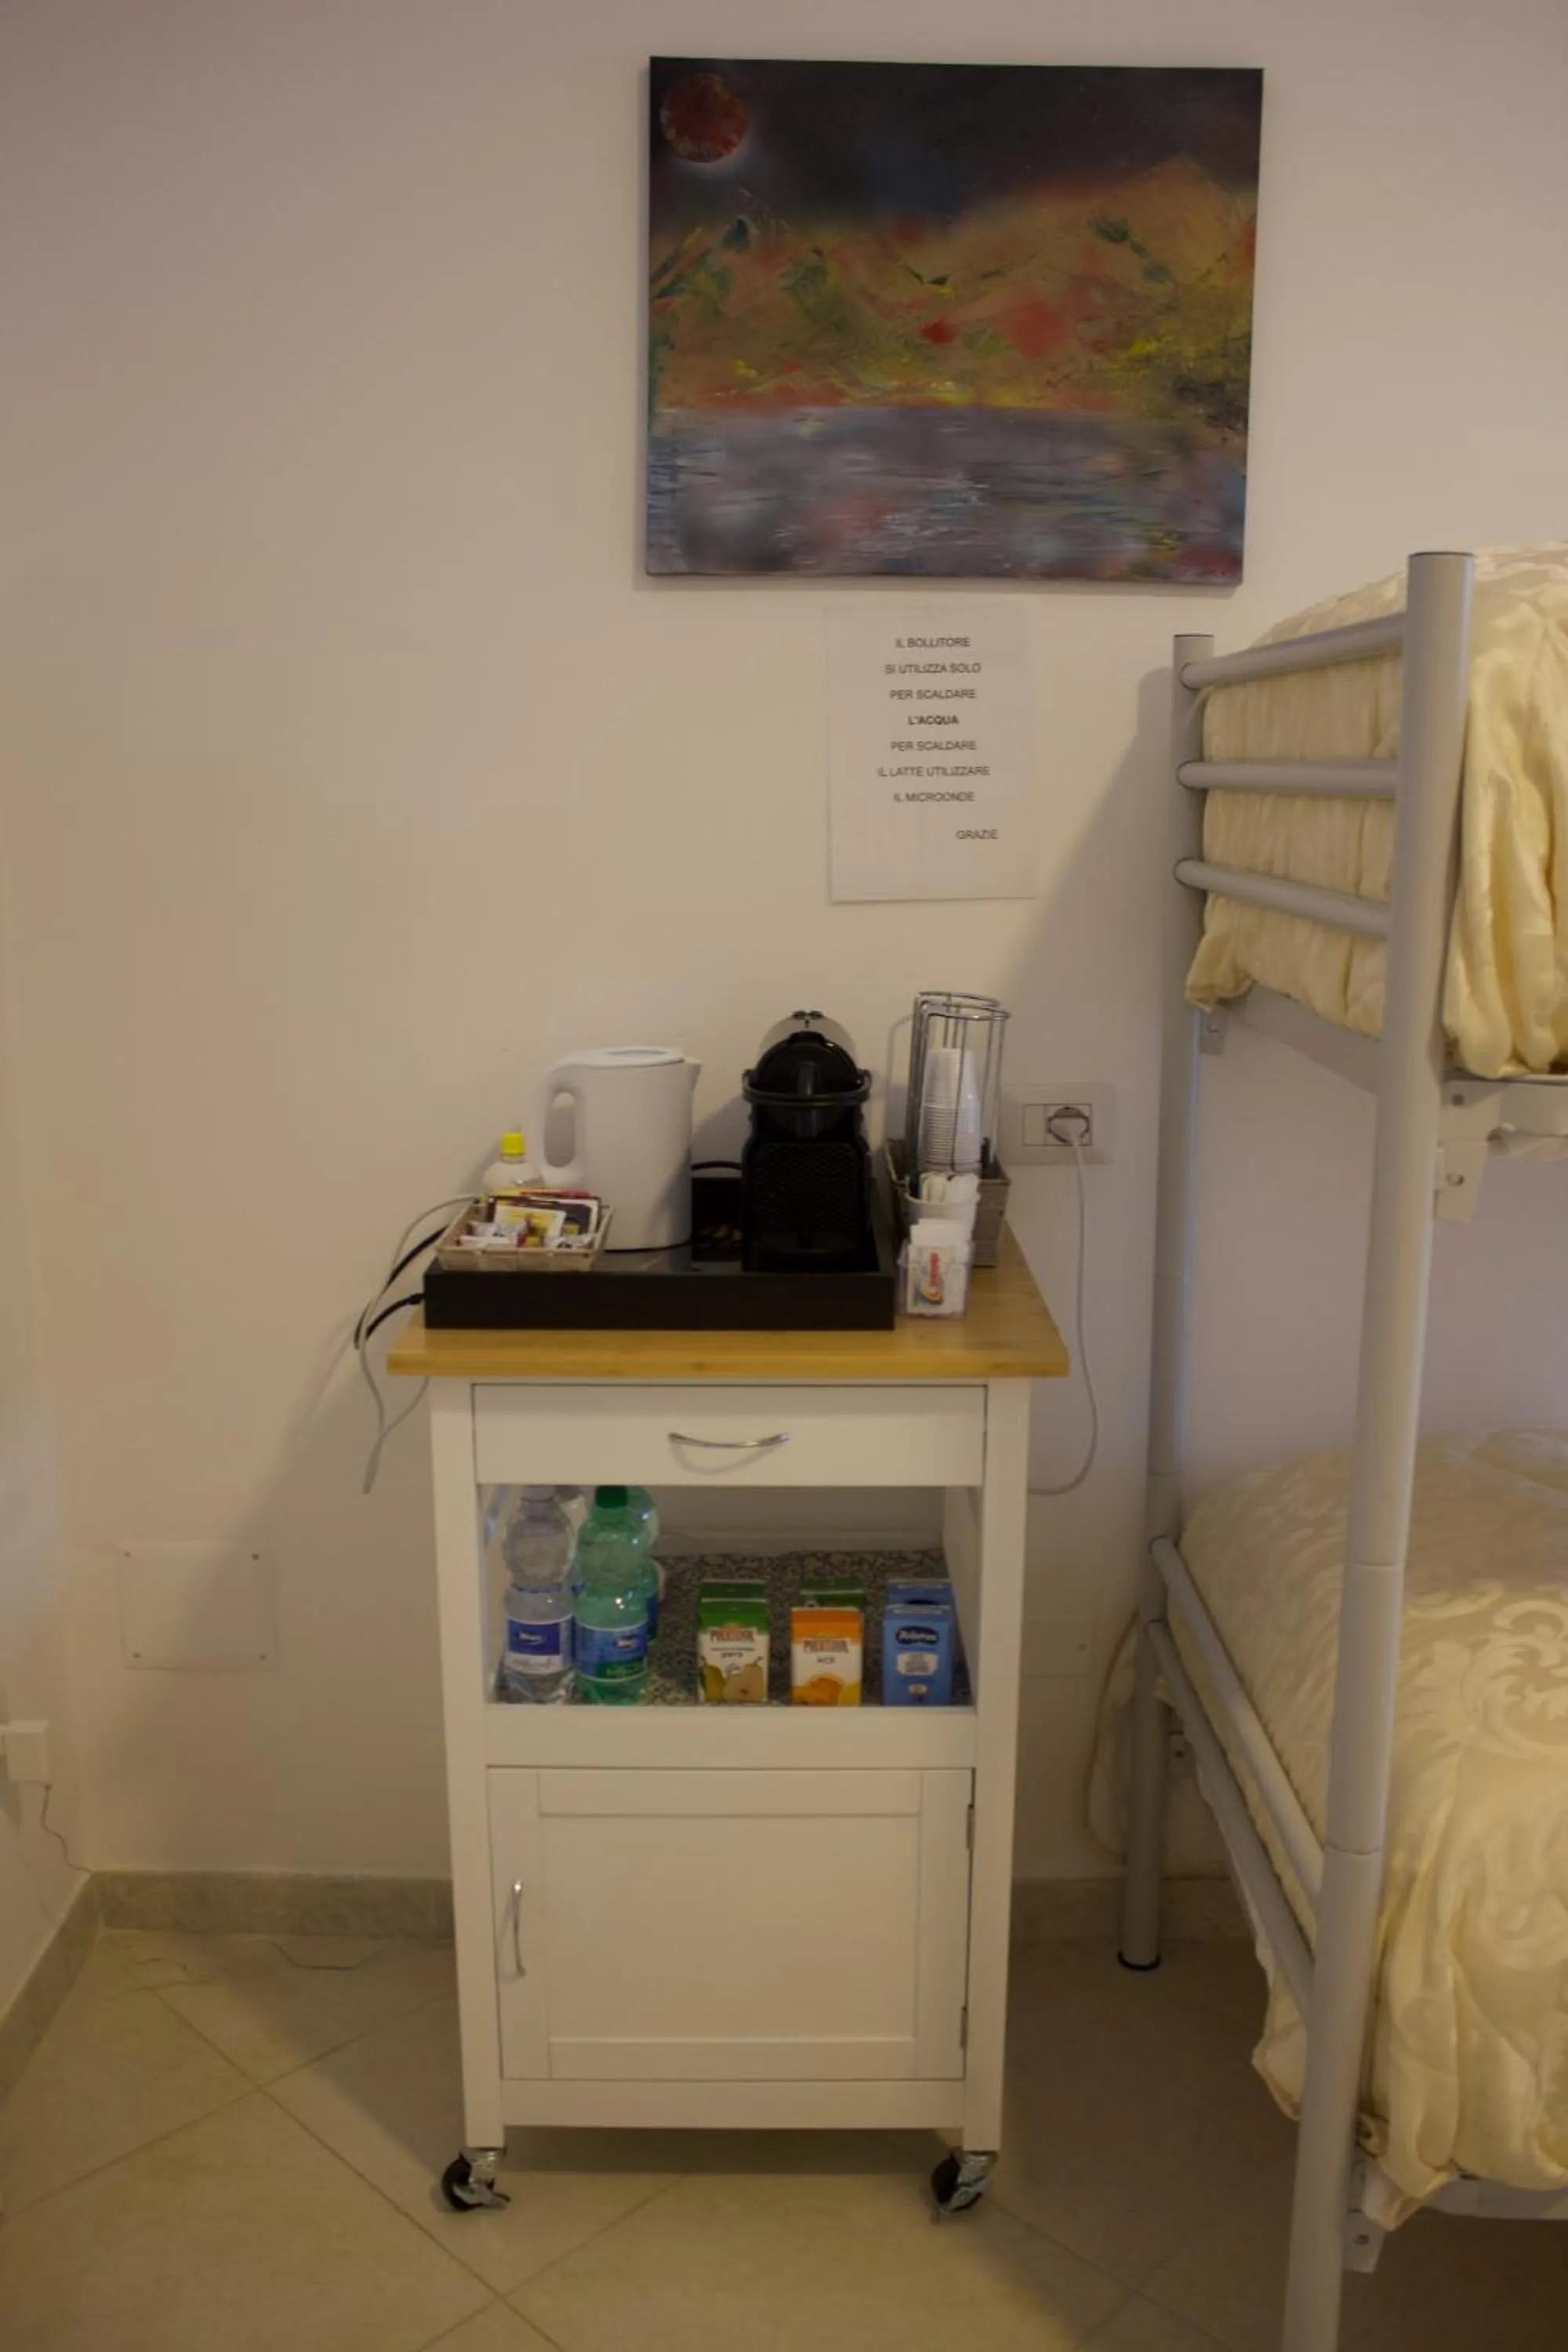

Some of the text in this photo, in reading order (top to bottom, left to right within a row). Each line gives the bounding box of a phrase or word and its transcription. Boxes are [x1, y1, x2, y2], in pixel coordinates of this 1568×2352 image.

[895, 637, 971, 649] IL BOLLITORE
[884, 662, 982, 675] SI UTILIZZA SOLO
[889, 688, 977, 701] PER SCALDARE
[907, 714, 960, 726] L'ACQUA
[890, 739, 978, 752] PER SCALDARE
[877, 765, 991, 778] IL LATTE UTILIZZARE
[893, 791, 975, 804] IL MICROONDE
[955, 829, 1000, 840] GRAZIE
